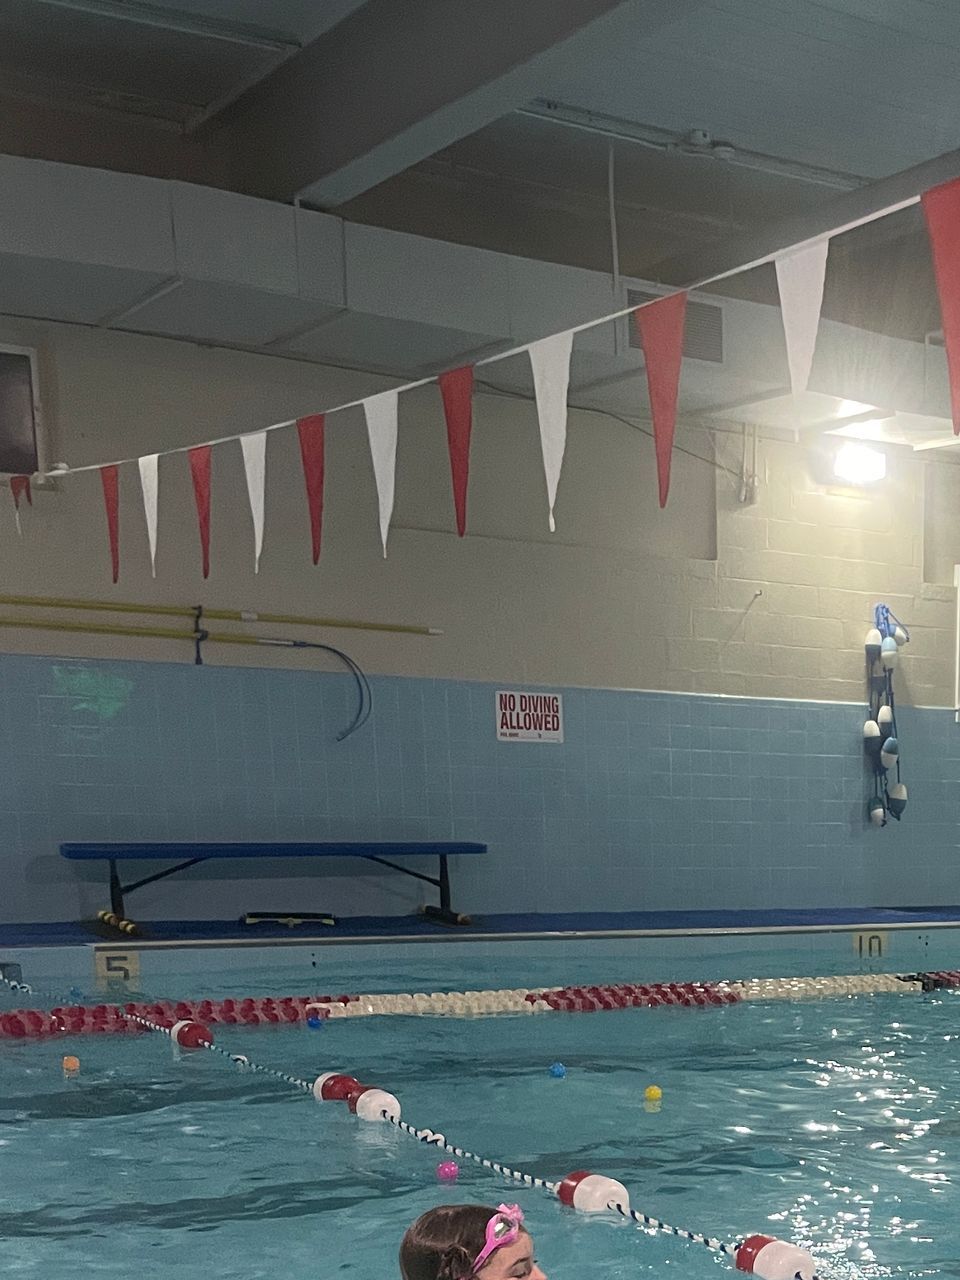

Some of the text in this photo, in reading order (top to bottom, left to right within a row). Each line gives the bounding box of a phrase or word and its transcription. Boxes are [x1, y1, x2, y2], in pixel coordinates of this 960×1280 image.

[499, 694, 559, 714] NO DIVING
[500, 712, 560, 732] ALLOWED
[858, 935, 882, 958] 10
[105, 956, 130, 981] 5
